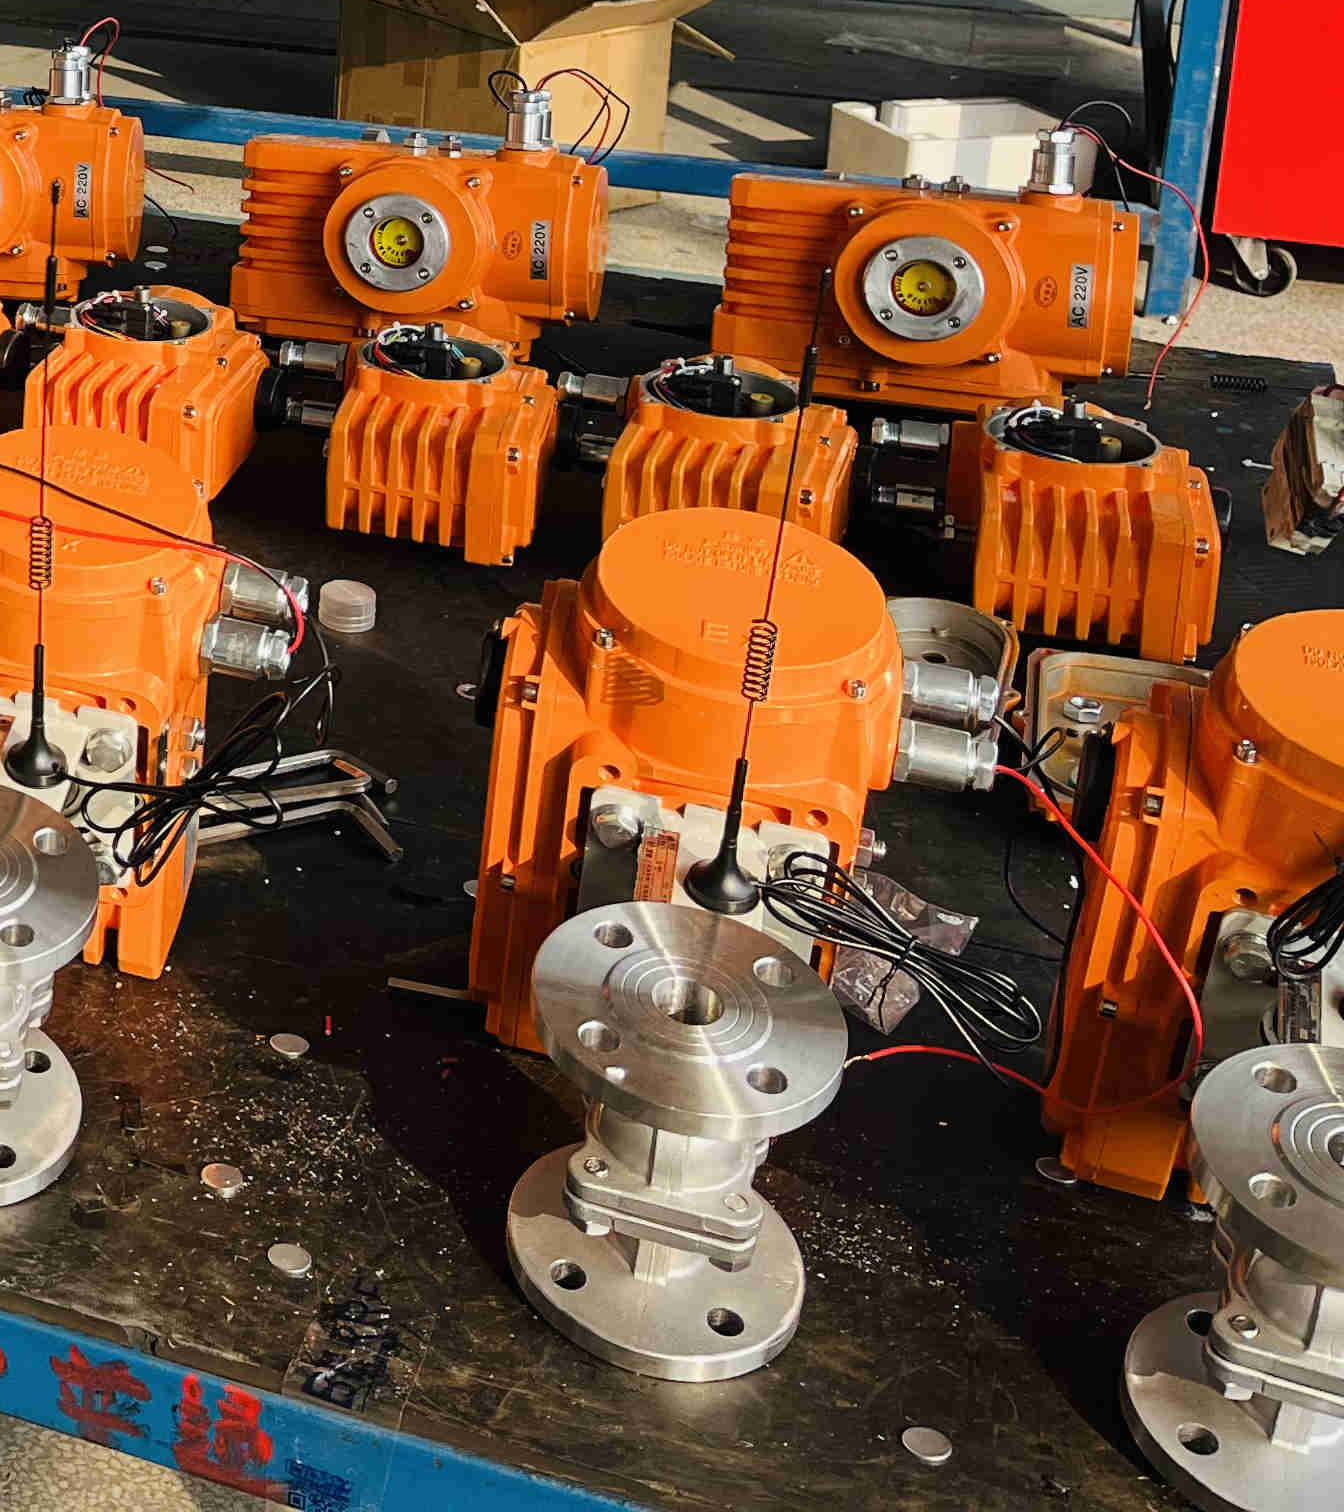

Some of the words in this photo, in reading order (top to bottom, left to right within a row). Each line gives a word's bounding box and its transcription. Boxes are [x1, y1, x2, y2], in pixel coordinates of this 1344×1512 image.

[76, 199, 87, 217] AC
[534, 222, 546, 255] 220V
[533, 260, 545, 279] AC
[1073, 266, 1088, 301] 220V
[1072, 306, 1085, 327] AC
